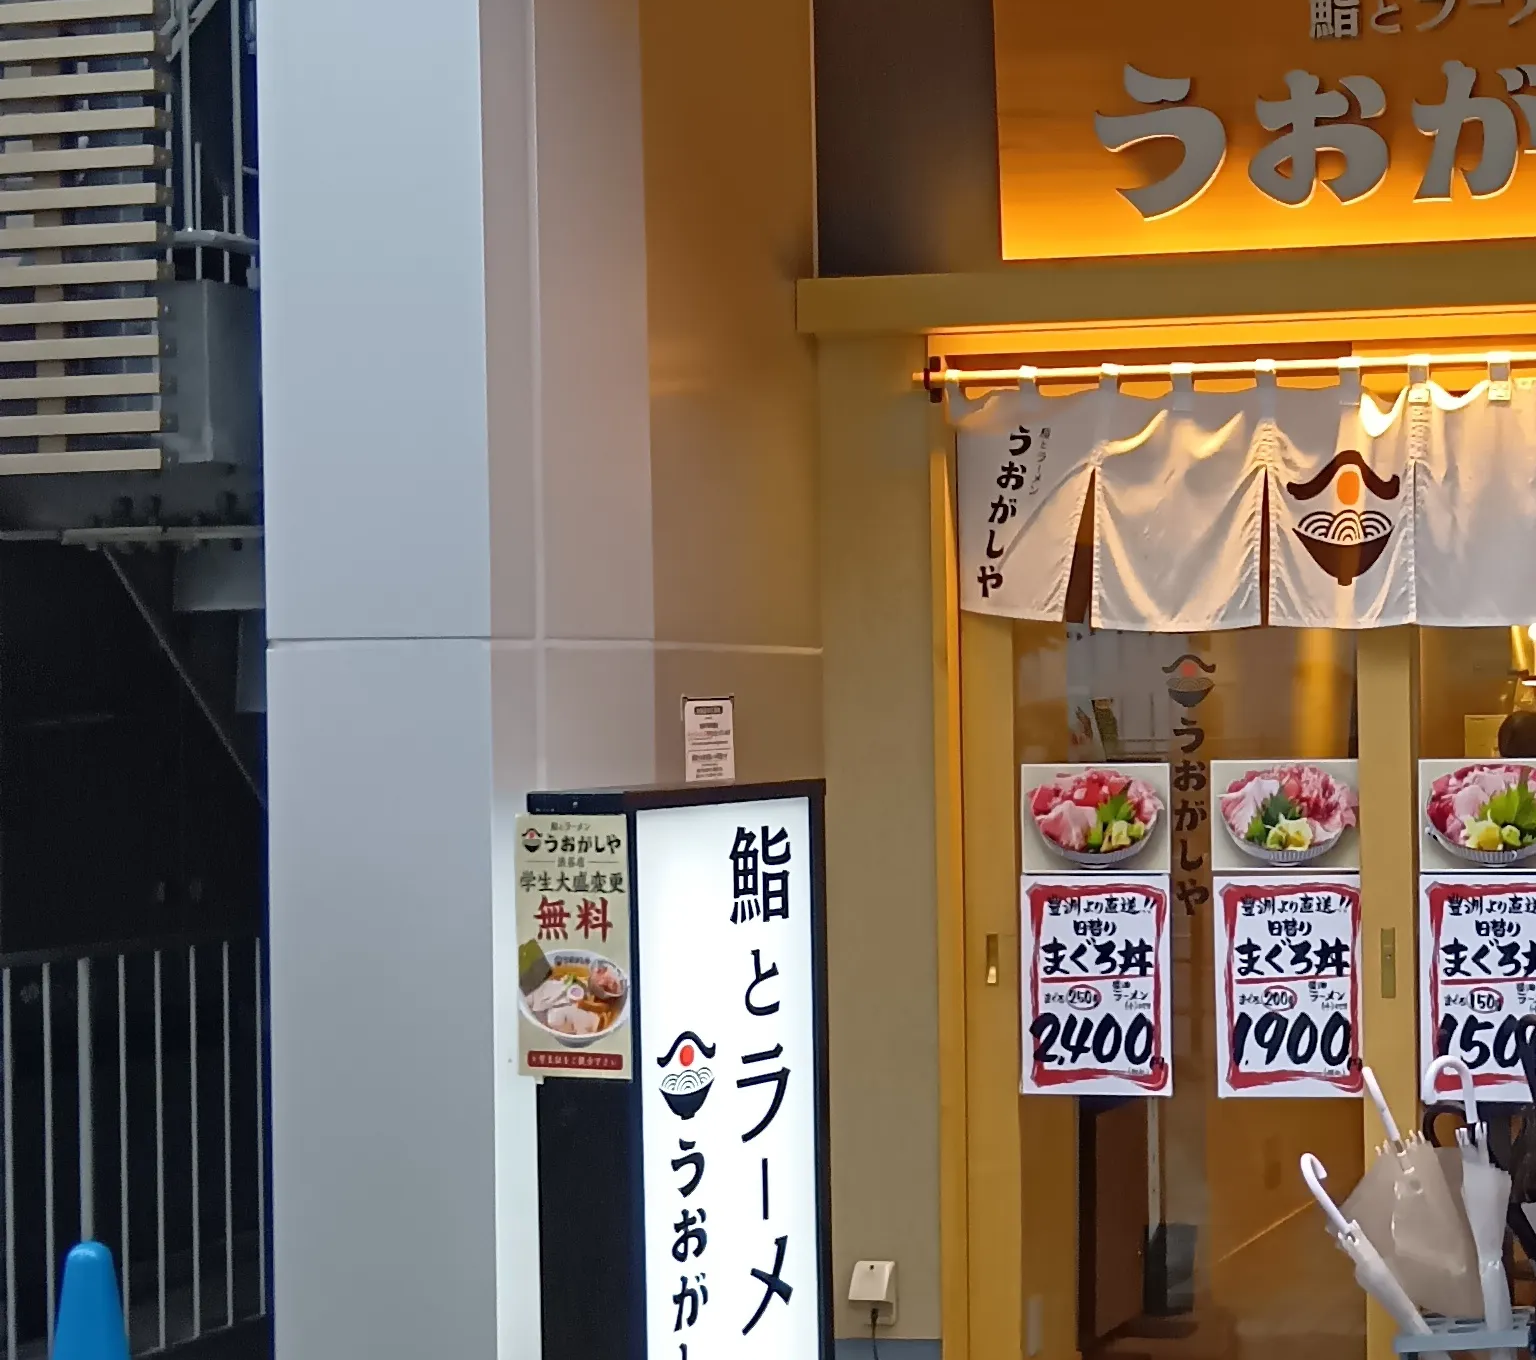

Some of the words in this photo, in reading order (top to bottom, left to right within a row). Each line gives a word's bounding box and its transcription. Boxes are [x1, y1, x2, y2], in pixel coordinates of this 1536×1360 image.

[977, 424, 1032, 598] うおがしや
[1171, 718, 1210, 916] うおがしや
[544, 833, 622, 854] うおがしや
[533, 894, 614, 944] 無料
[1073, 919, 1117, 936] 日替り
[1267, 919, 1313, 937] 日替り
[1475, 918, 1521, 937] 日替り
[1041, 936, 1154, 976] まぐろ丼
[1235, 937, 1350, 977] まぐろ丼
